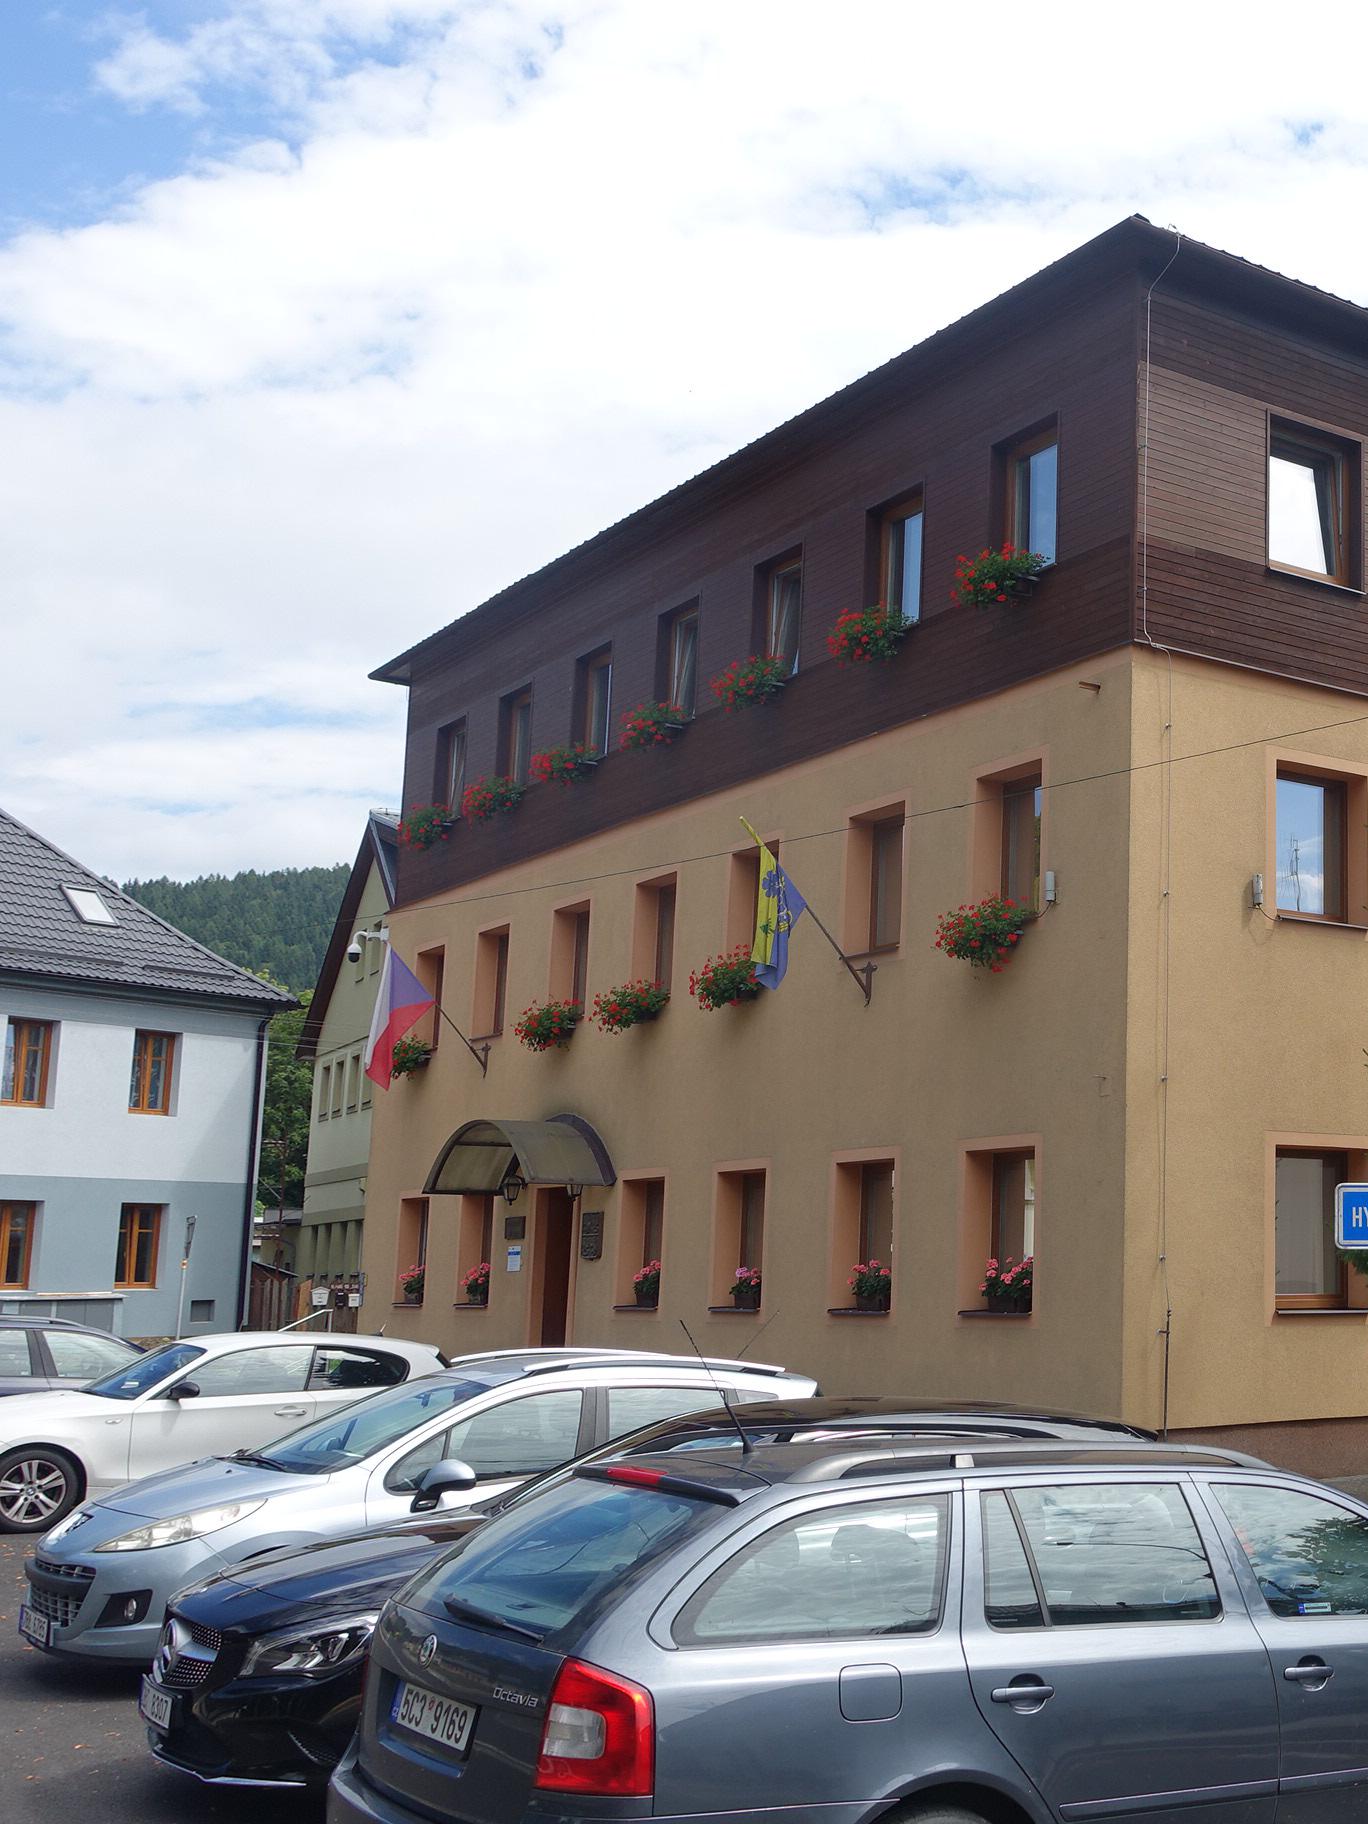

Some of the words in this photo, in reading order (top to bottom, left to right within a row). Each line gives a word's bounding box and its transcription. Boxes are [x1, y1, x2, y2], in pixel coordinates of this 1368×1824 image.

[401, 1687, 427, 1728] 5C3
[430, 1700, 468, 1745] 9169
[492, 1687, 539, 1708] Octavia
